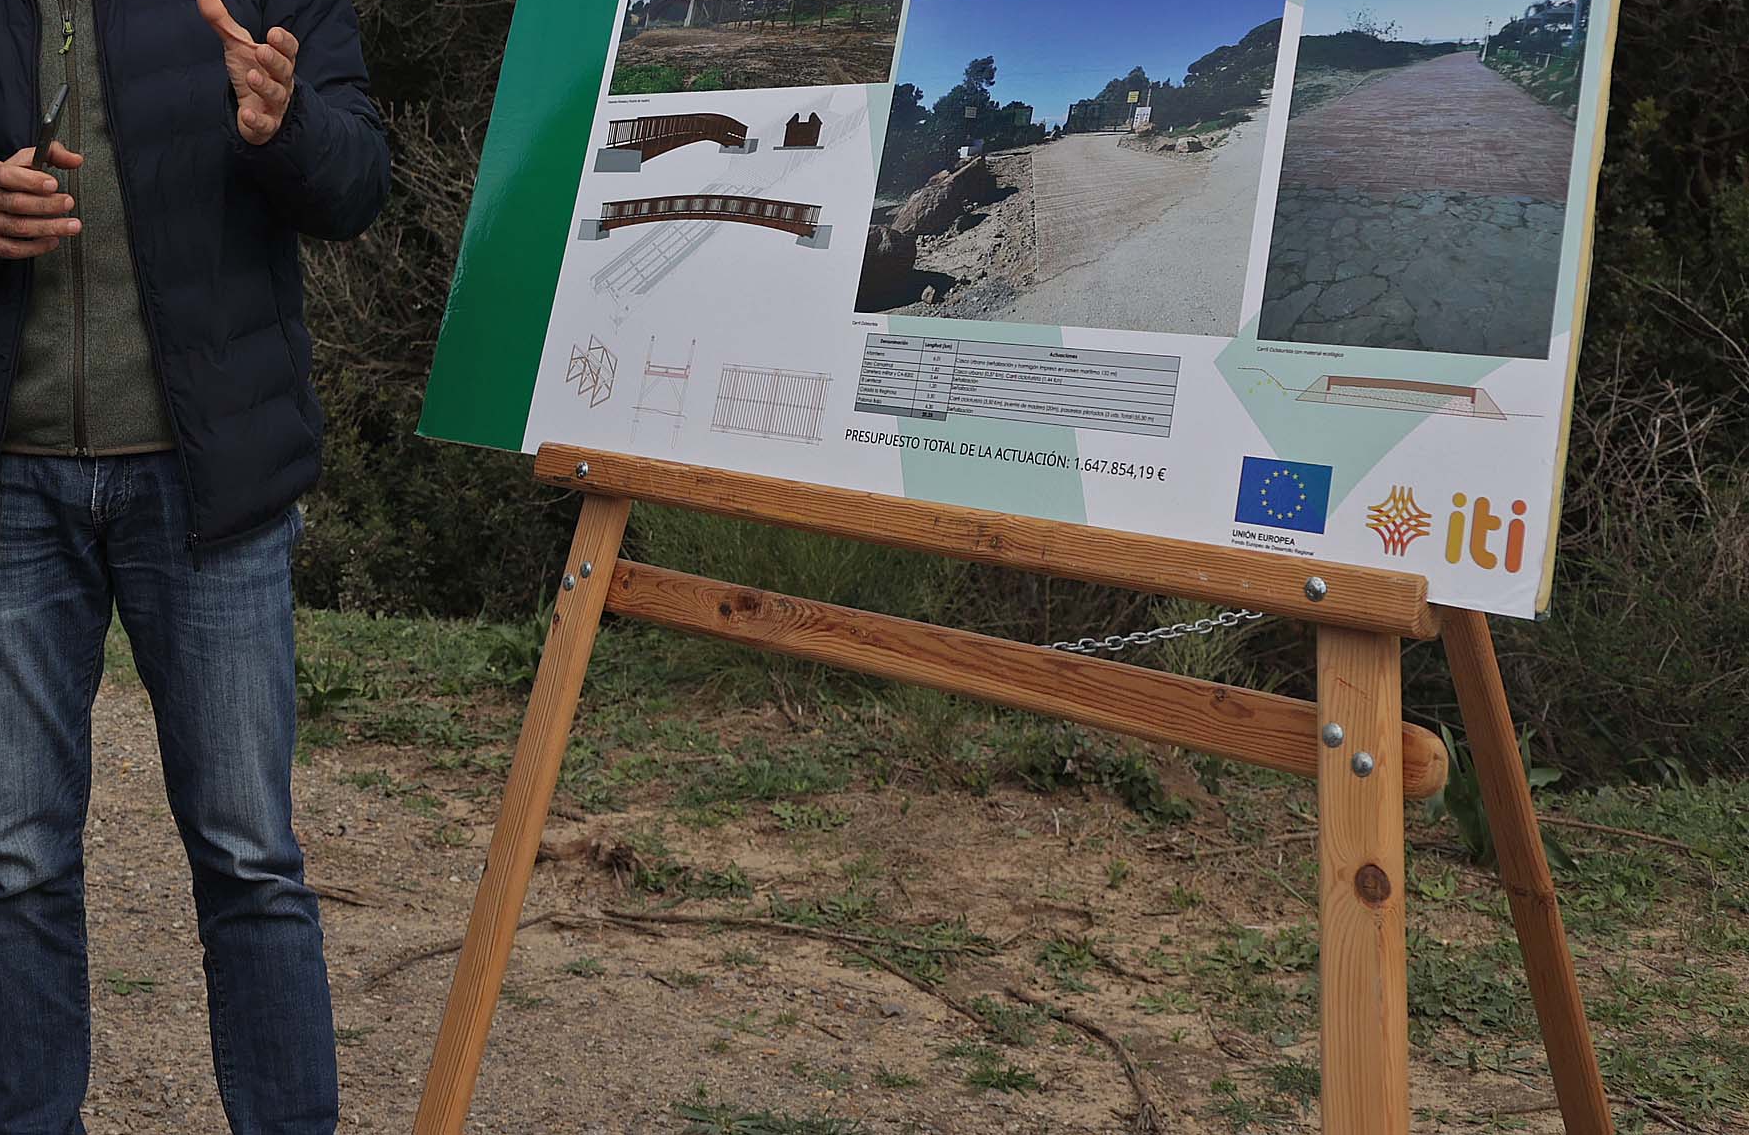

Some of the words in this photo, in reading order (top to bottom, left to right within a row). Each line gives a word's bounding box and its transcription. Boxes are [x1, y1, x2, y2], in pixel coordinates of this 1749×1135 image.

[844, 428, 921, 450] PRESUPUESTO
[922, 437, 957, 455] TOTAL
[959, 442, 975, 457] DE
[977, 445, 994, 459] LA
[994, 447, 1071, 469] ACTUACIÓN:
[1072, 457, 1155, 480] 1.647.854,19
[1156, 467, 1167, 482] €
[1232, 529, 1257, 540] UNIÓN
[1258, 533, 1296, 545] EUROPEA
[1445, 492, 1527, 573] iti
